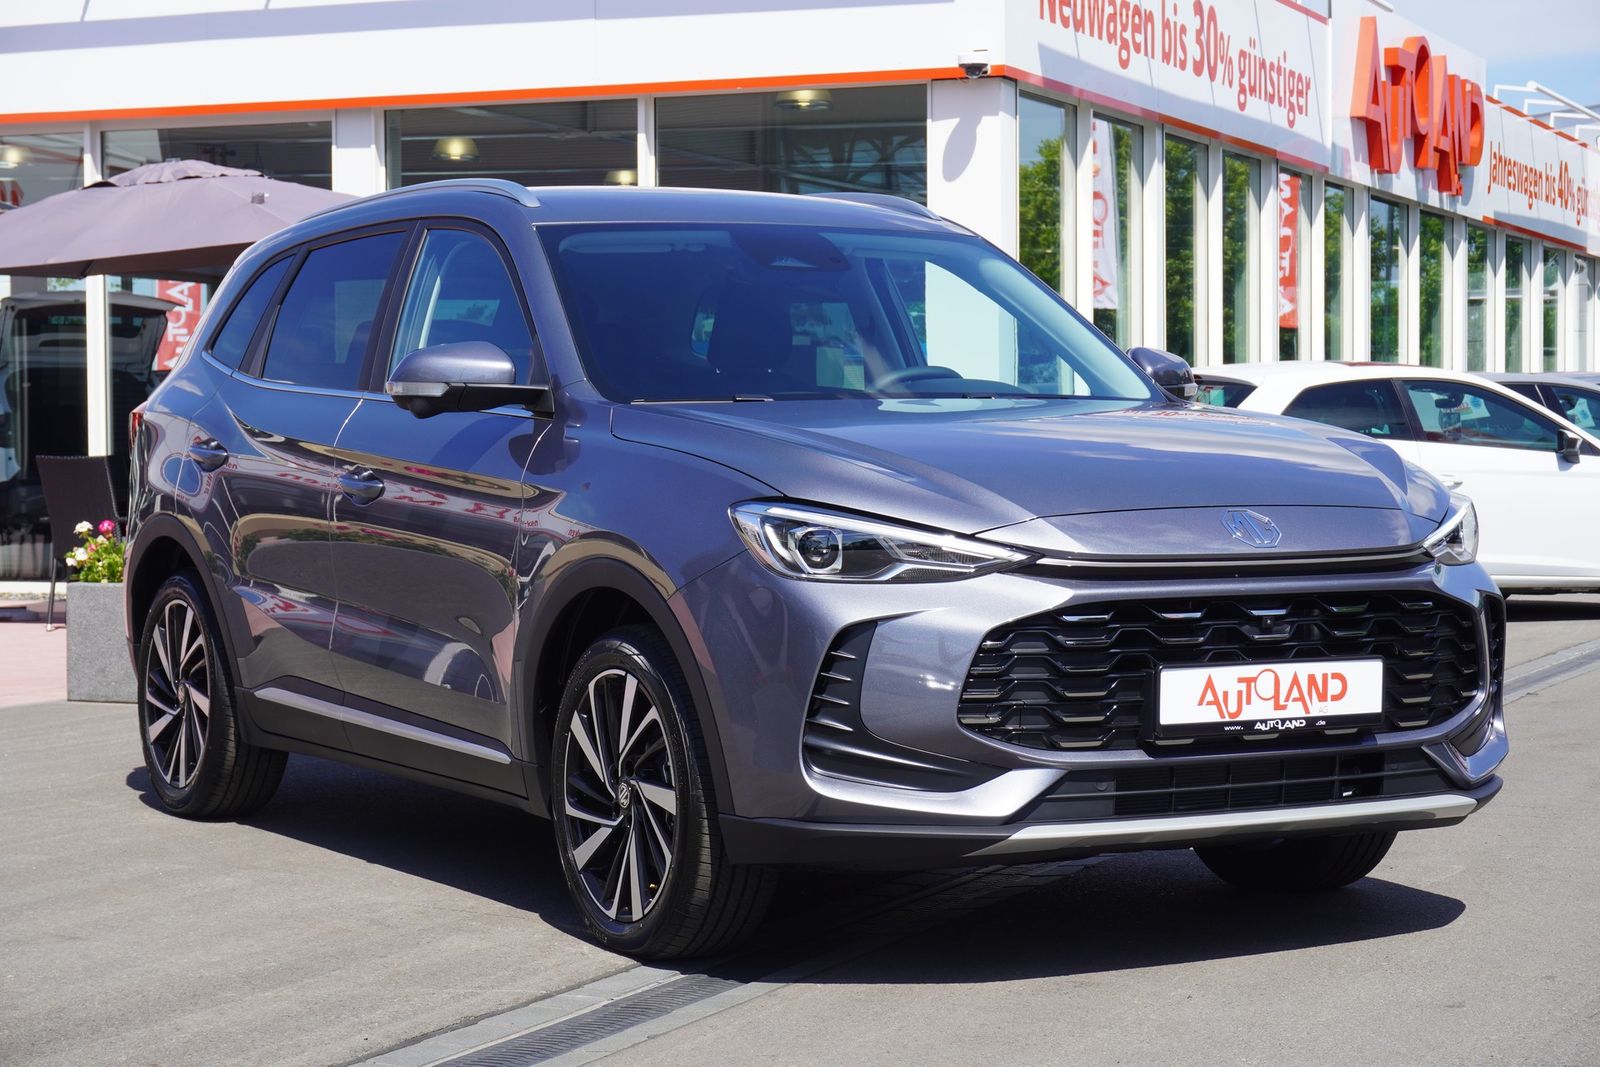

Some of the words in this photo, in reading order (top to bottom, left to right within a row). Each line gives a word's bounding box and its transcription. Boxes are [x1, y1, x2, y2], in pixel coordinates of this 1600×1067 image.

[1161, 0, 1188, 71] bis
[1192, 0, 1234, 89] 30%
[1237, 37, 1311, 129] günstiger
[1488, 140, 1543, 210] Jahreswagen
[1544, 162, 1556, 206] bis
[1558, 160, 1576, 212] 40%
[1198, 668, 1348, 719] AUTOLAND
[1254, 719, 1307, 731] AUTOLAND
